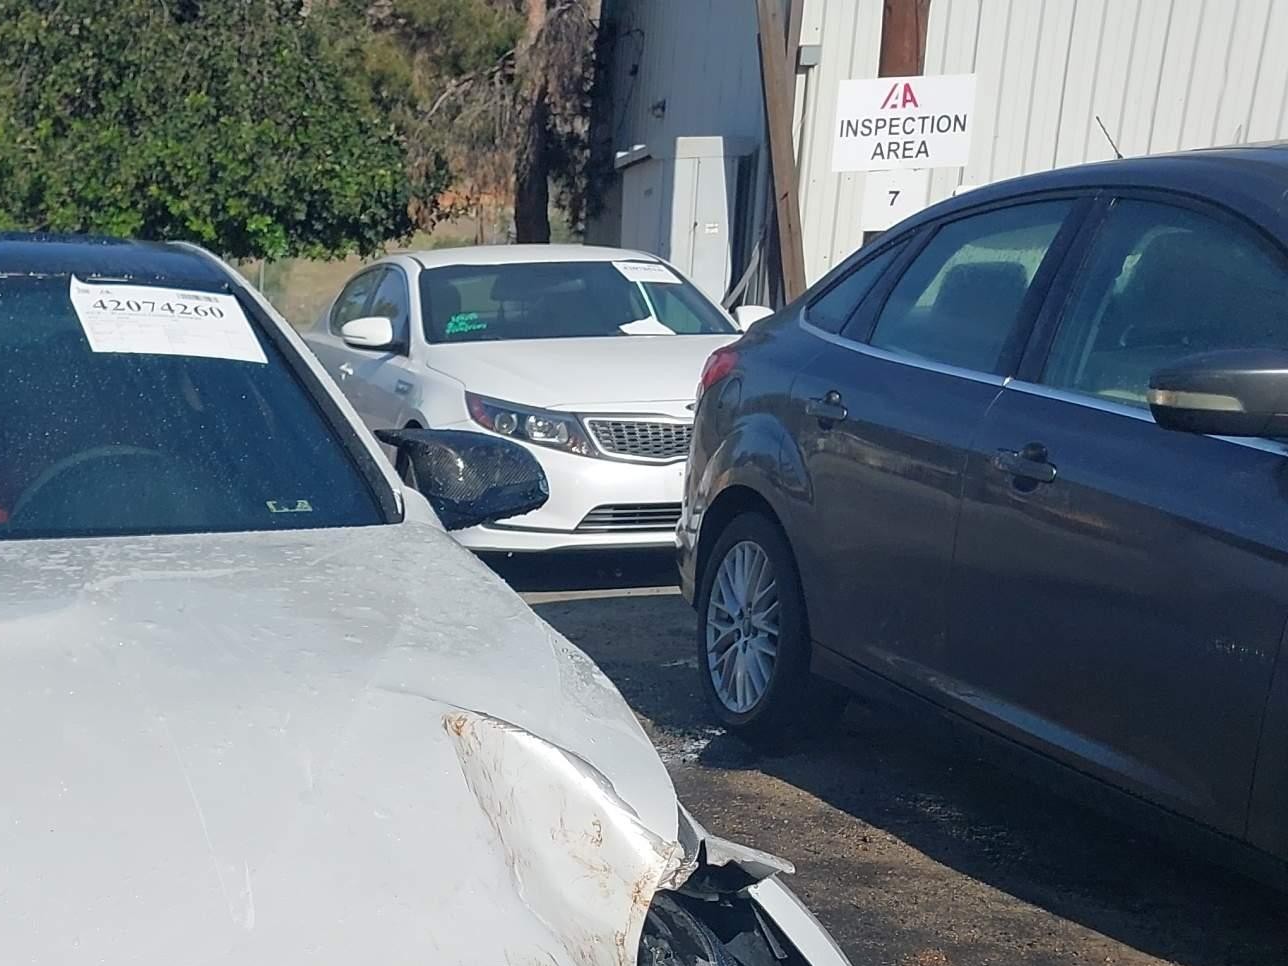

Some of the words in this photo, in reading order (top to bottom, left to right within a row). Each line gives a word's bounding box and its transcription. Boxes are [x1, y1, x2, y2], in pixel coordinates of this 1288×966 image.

[839, 113, 967, 138] INSPECTION
[871, 140, 929, 160] AREA
[888, 190, 900, 207] 7
[92, 298, 225, 319] 42074260
